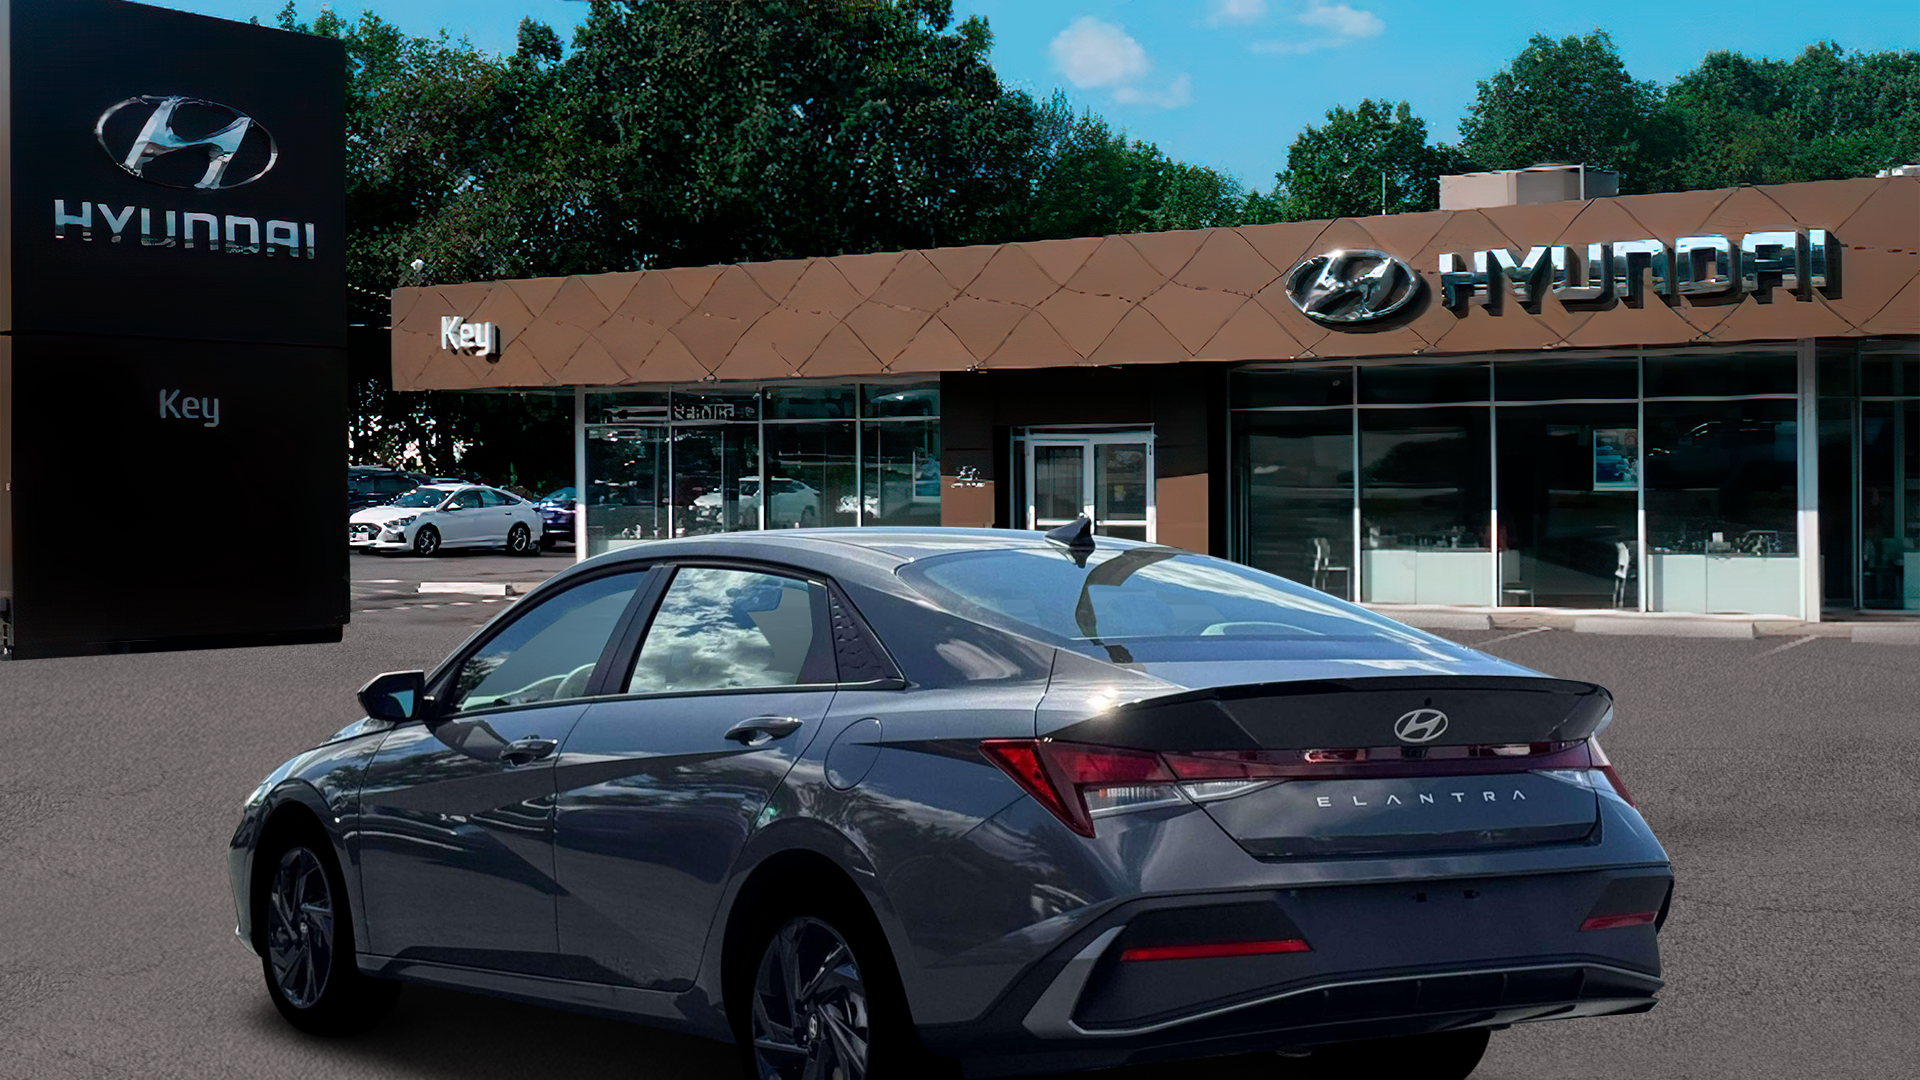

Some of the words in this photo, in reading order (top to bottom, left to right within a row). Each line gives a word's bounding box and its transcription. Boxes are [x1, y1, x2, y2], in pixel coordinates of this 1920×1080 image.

[54, 199, 315, 260] HYUNDAI
[1438, 228, 1830, 308] HYUNDAI
[441, 315, 494, 357] Key
[159, 388, 220, 428] Key
[1316, 789, 1527, 808] ELANTRA
